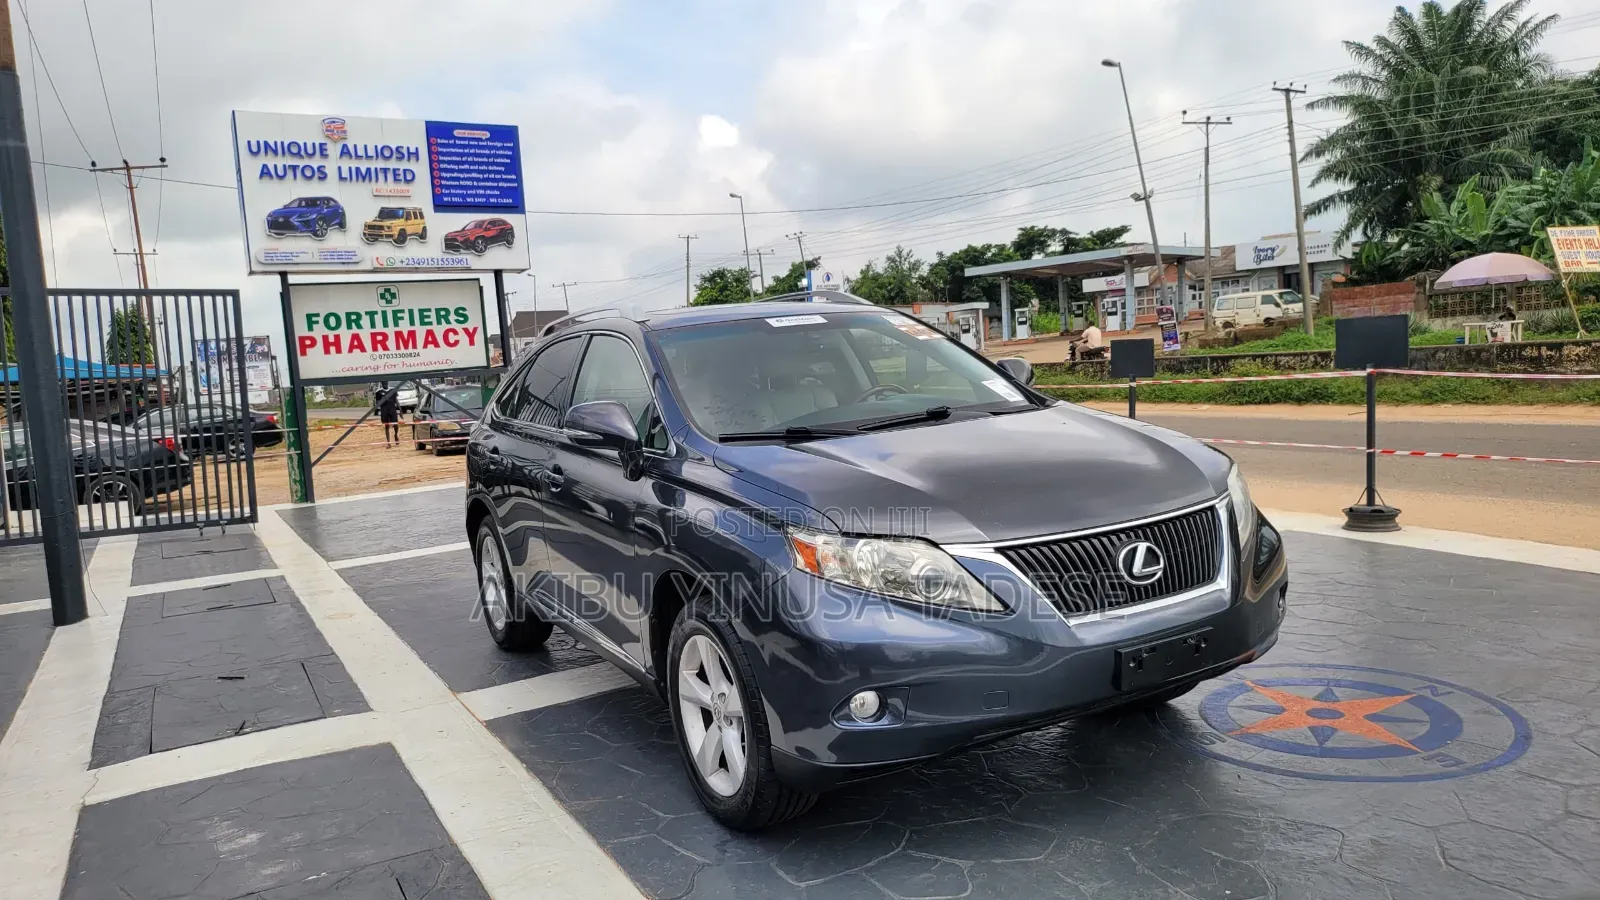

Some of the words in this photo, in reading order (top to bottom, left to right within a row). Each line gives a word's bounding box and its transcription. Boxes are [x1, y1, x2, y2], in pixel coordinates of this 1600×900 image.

[247, 140, 329, 159] UNIQUE
[339, 143, 420, 162] ALLIOSH
[259, 163, 328, 180] AUTOS
[338, 165, 416, 184] LIMITED
[1253, 245, 1279, 255] Ivory
[400, 257, 469, 266] +2349151553961
[1253, 253, 1275, 266] Bites
[305, 306, 470, 332] FORTIFIERS
[297, 326, 479, 356] PHARMACY
[378, 351, 421, 360] 07033300824
[383, 361, 399, 371] for
